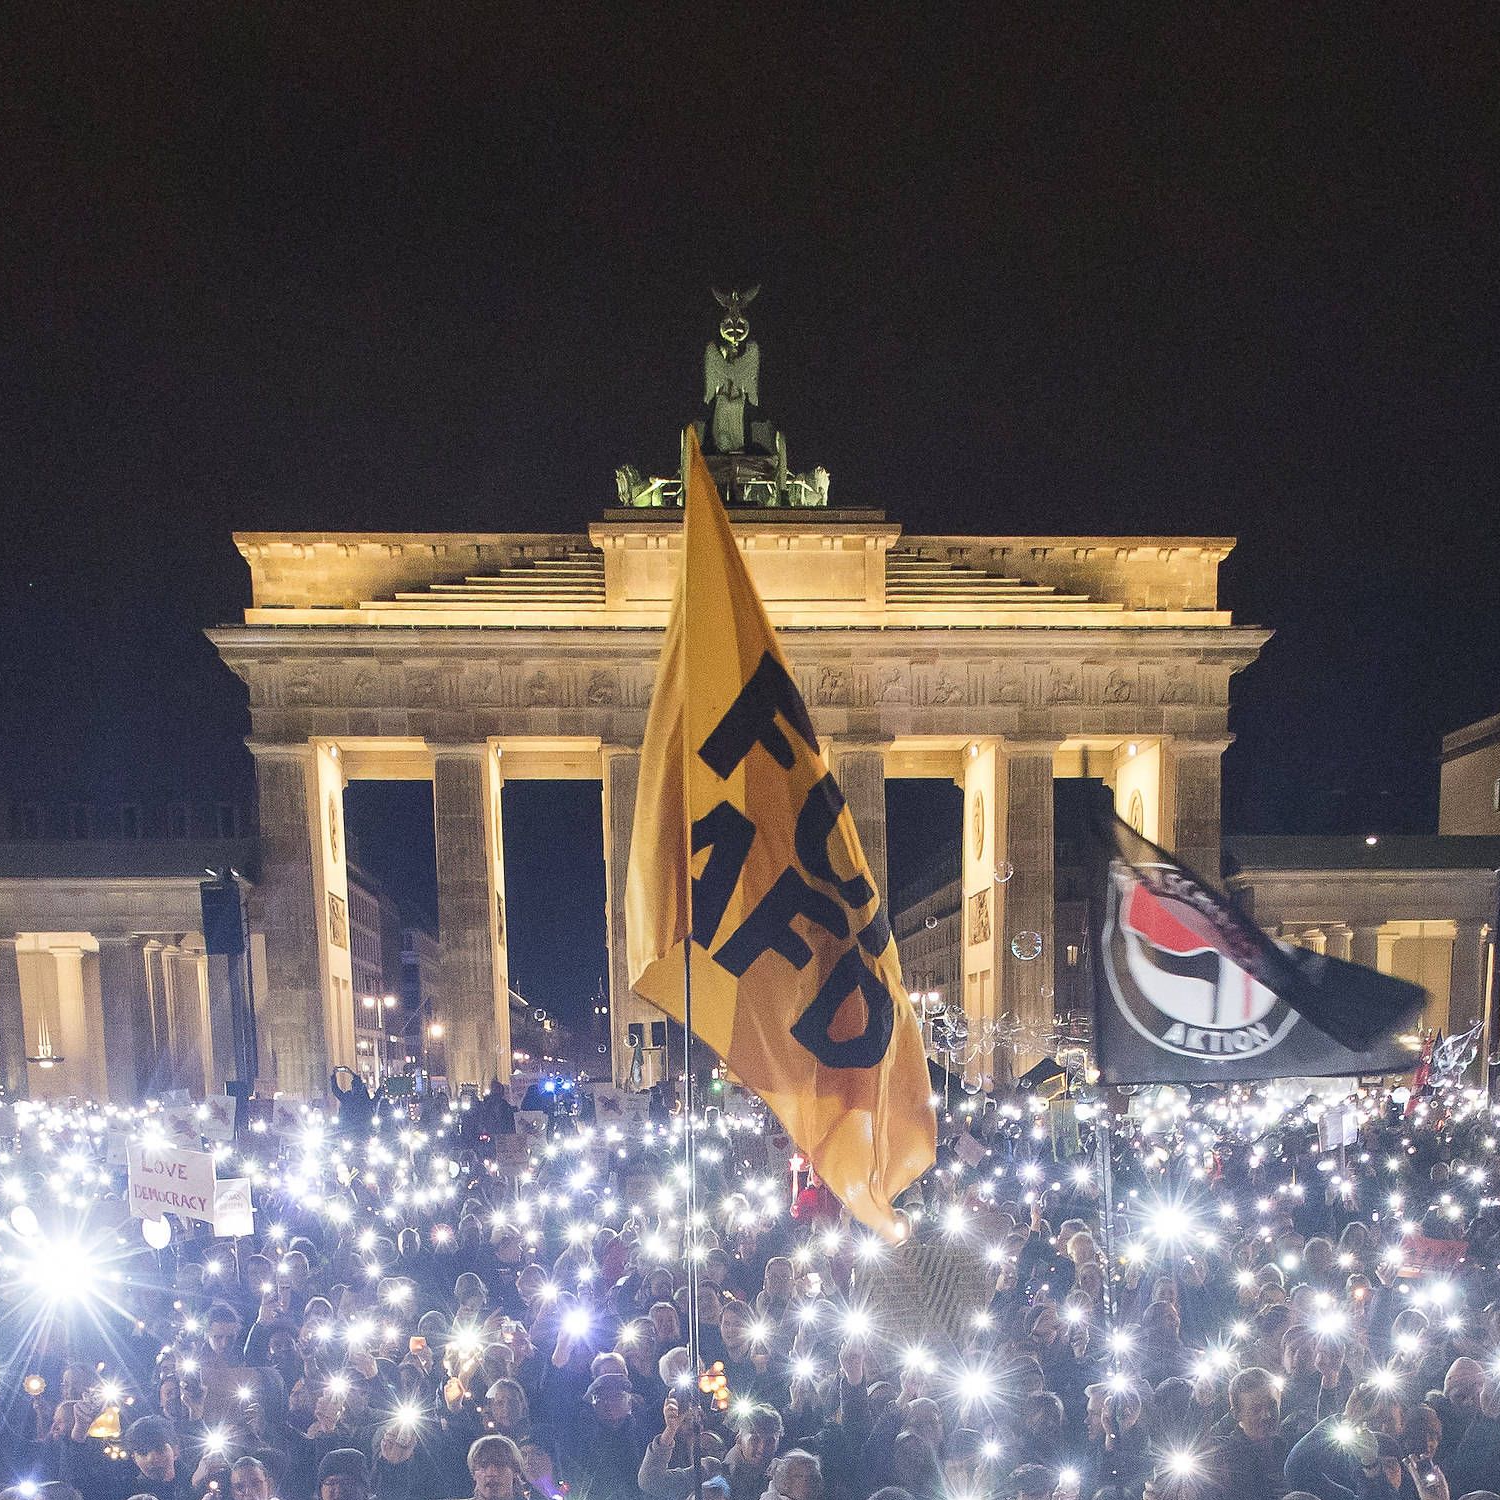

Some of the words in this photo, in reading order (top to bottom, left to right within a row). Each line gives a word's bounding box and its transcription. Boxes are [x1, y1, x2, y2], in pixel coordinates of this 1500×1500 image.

[697, 650, 890, 957] FC
[141, 1155, 188, 1180] LOVE
[134, 1184, 206, 1212] DEMOCRACY
